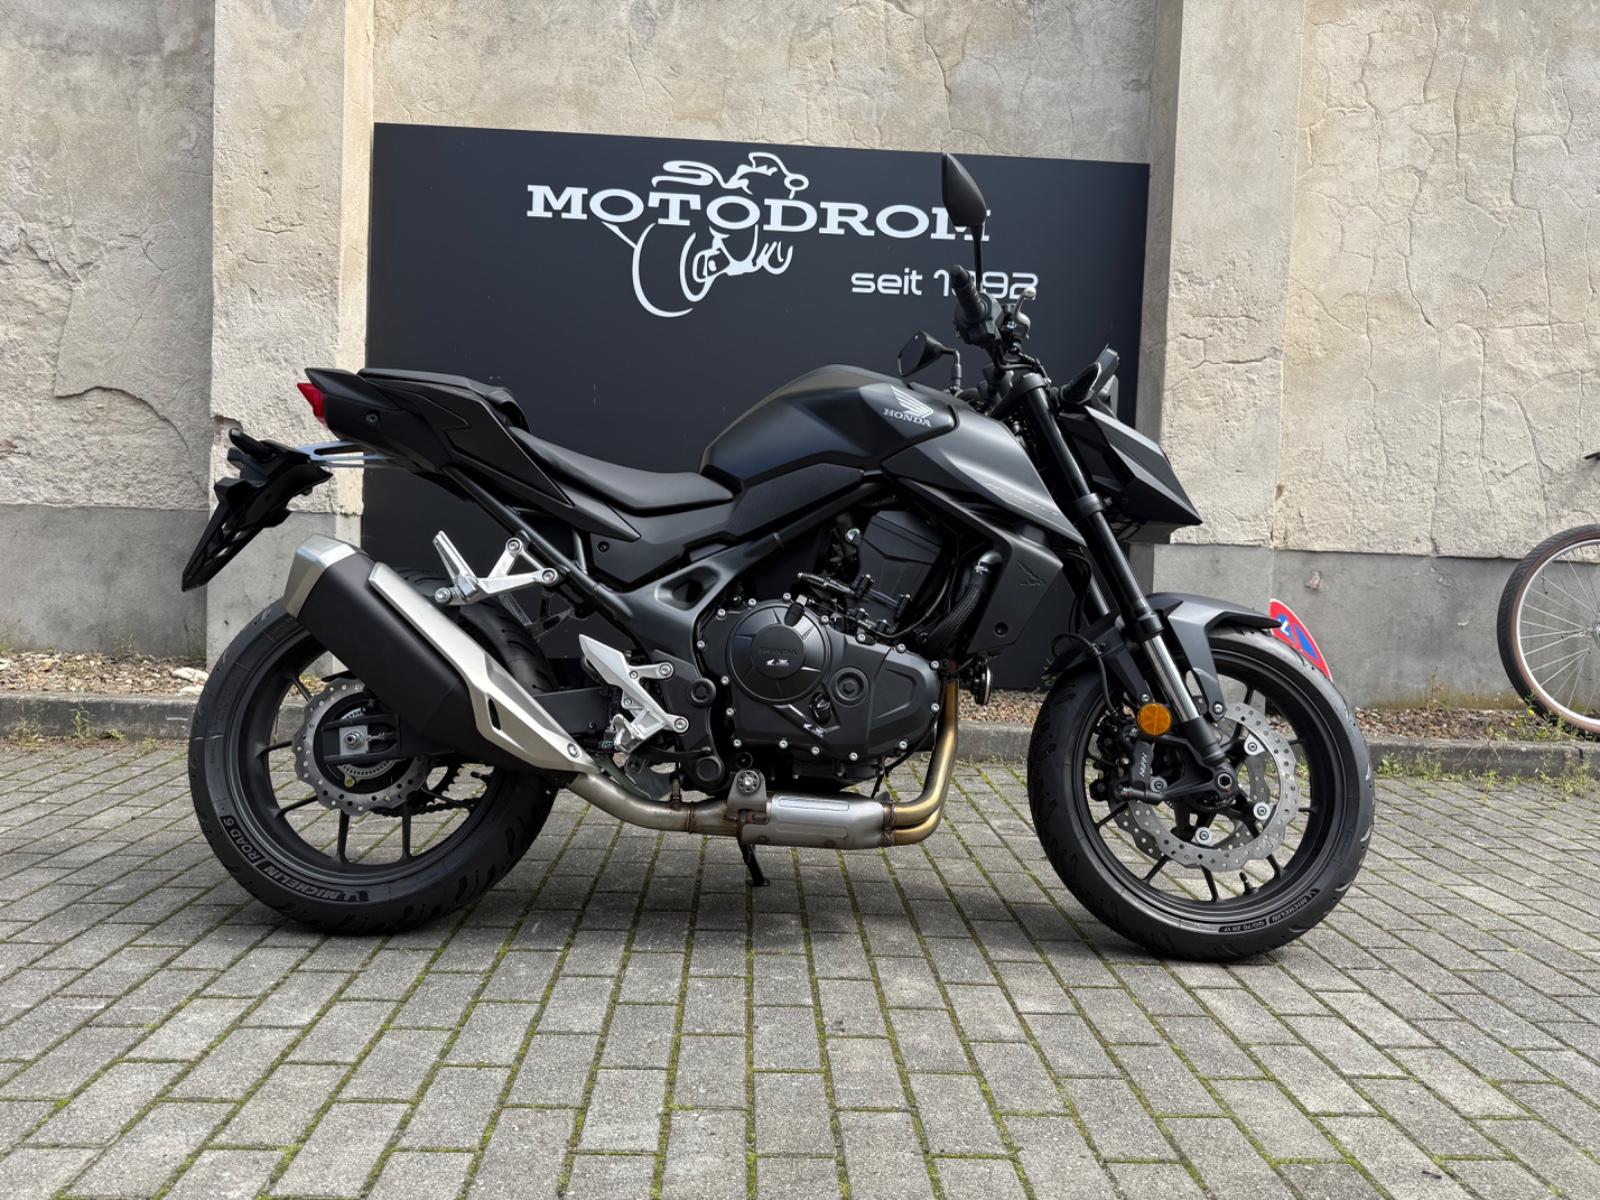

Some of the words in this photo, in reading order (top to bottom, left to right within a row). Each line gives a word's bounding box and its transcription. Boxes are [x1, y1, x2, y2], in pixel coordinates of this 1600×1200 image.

[851, 267, 923, 296] seit
[933, 269, 1039, 301] 192
[883, 408, 932, 427] HONDA
[229, 828, 260, 861] ROAD
[263, 864, 340, 900] MICHELIN
